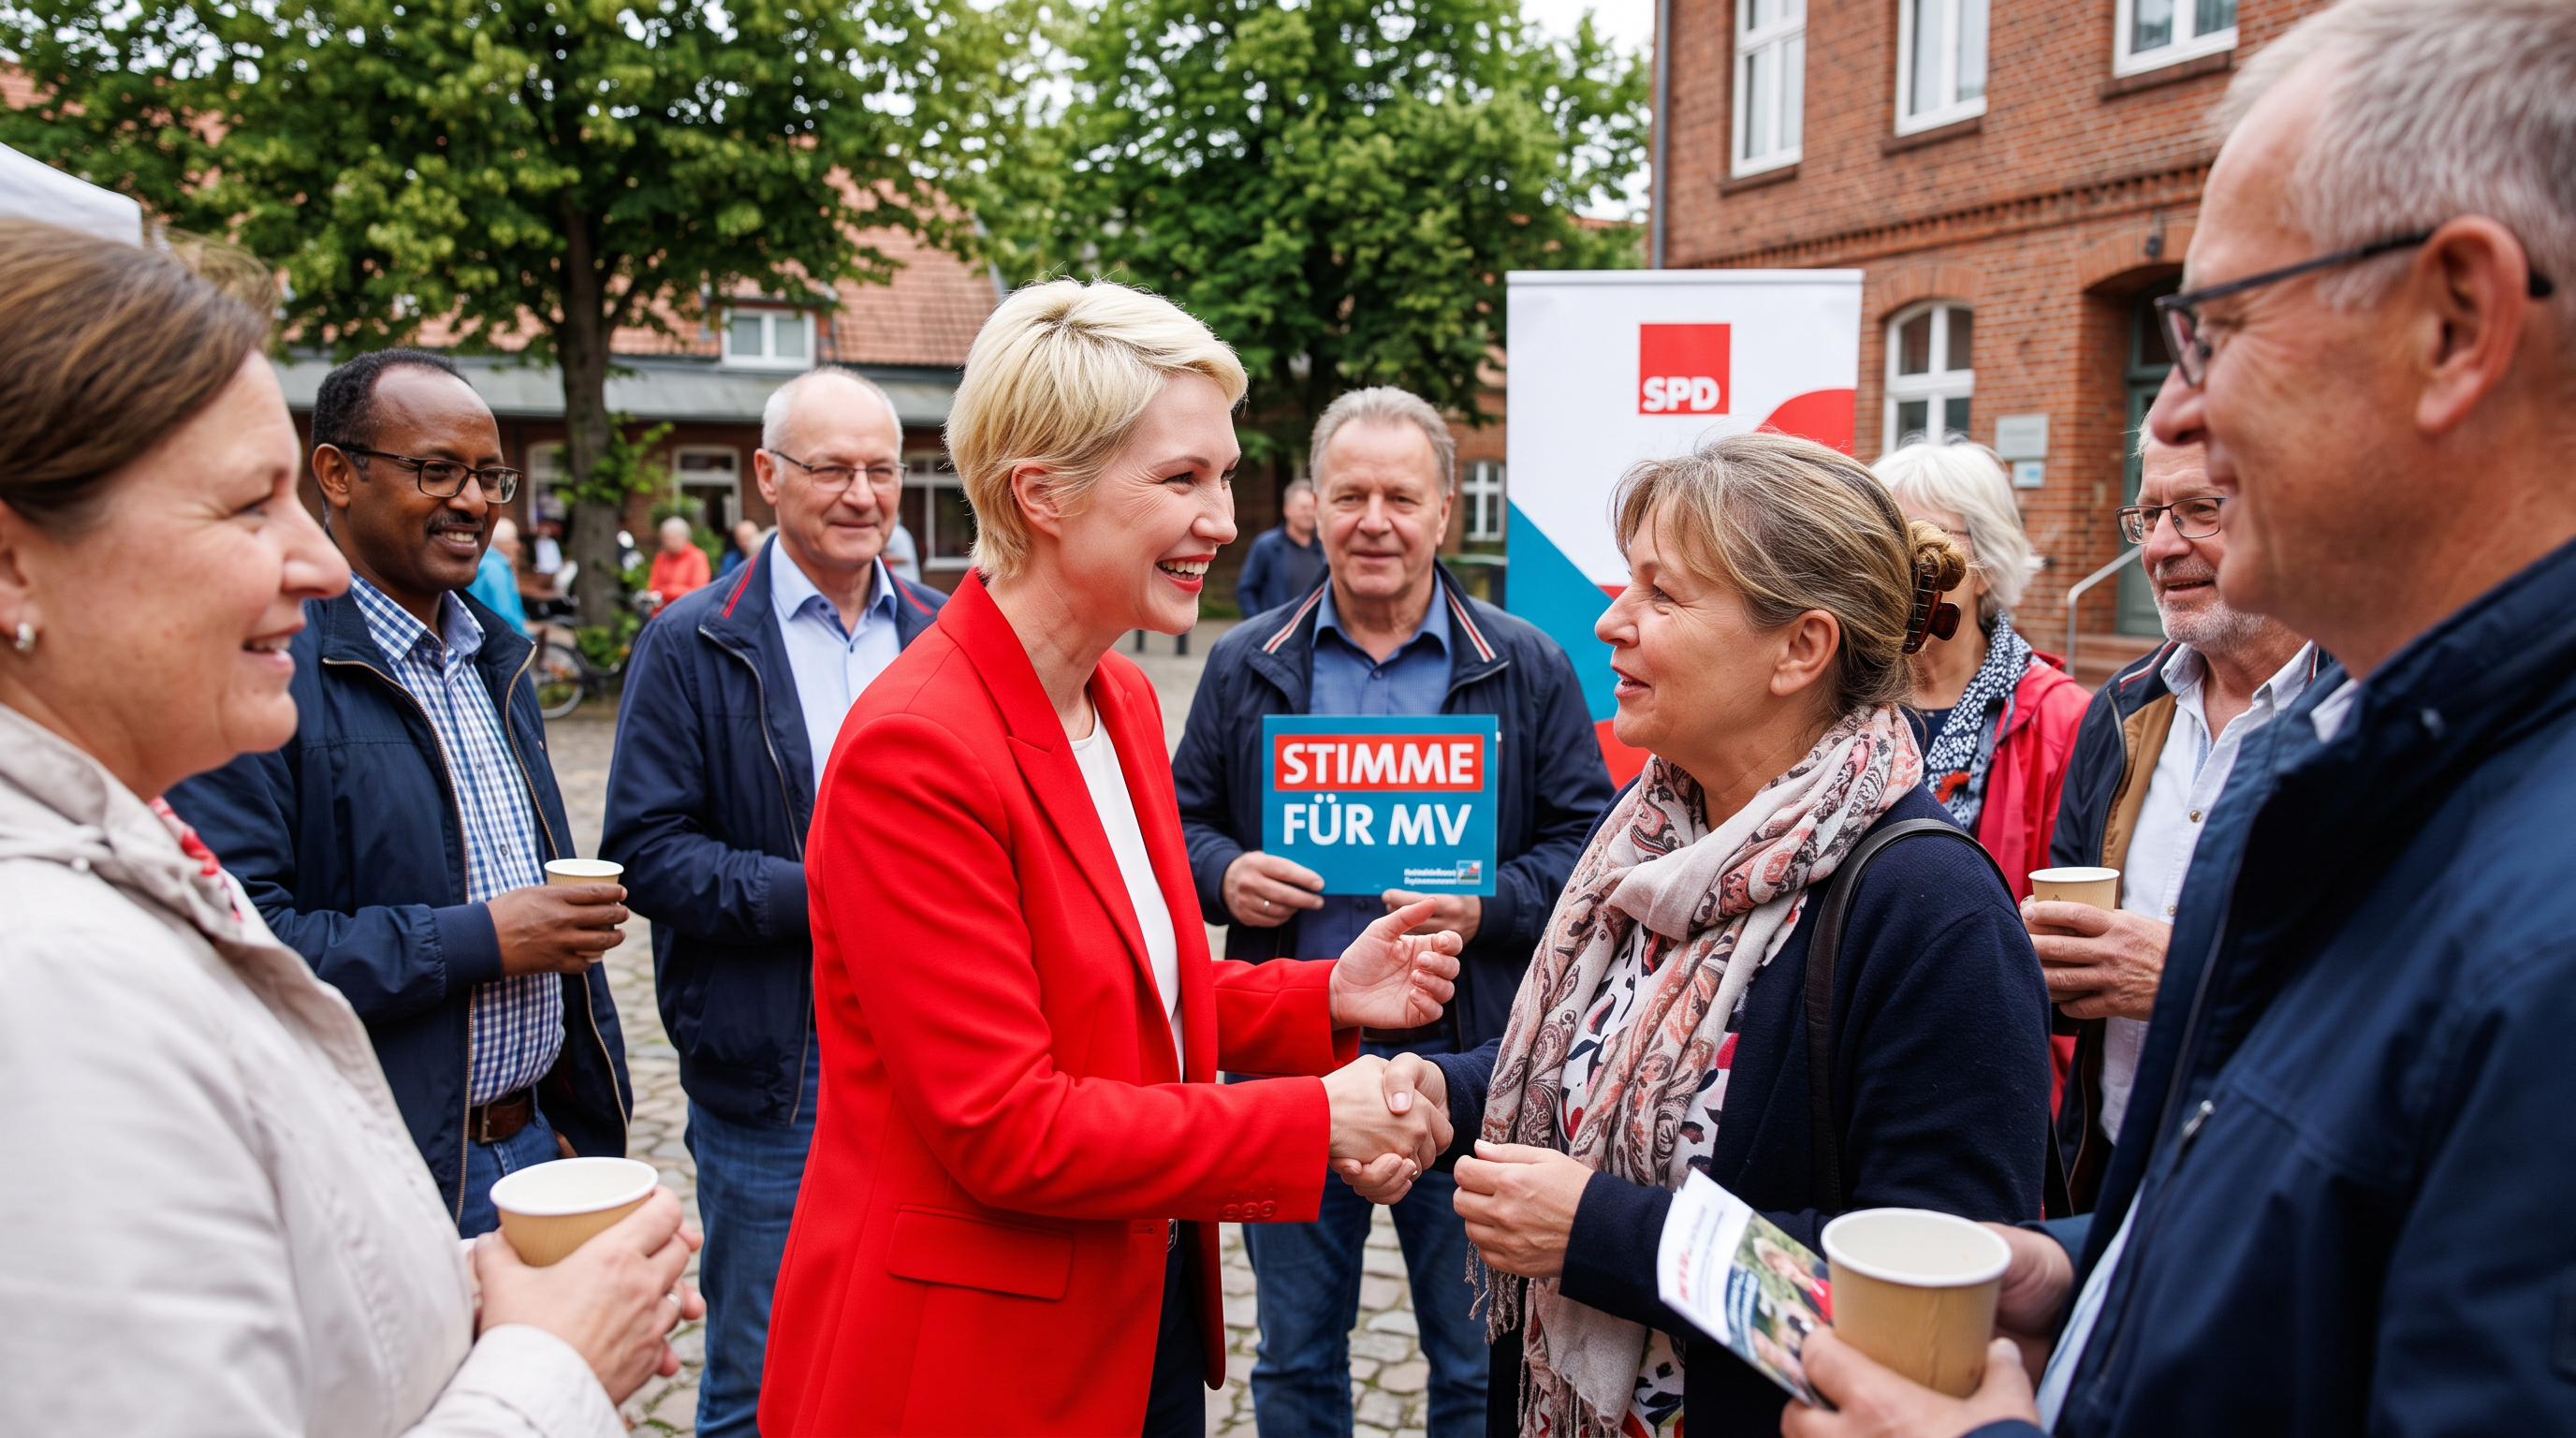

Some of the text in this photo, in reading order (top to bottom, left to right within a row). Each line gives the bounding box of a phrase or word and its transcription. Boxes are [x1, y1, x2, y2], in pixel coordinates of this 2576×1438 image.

[1642, 375, 1720, 412] SPD
[1282, 743, 1474, 784] STIMME
[1283, 794, 1472, 845] FÜR MV
